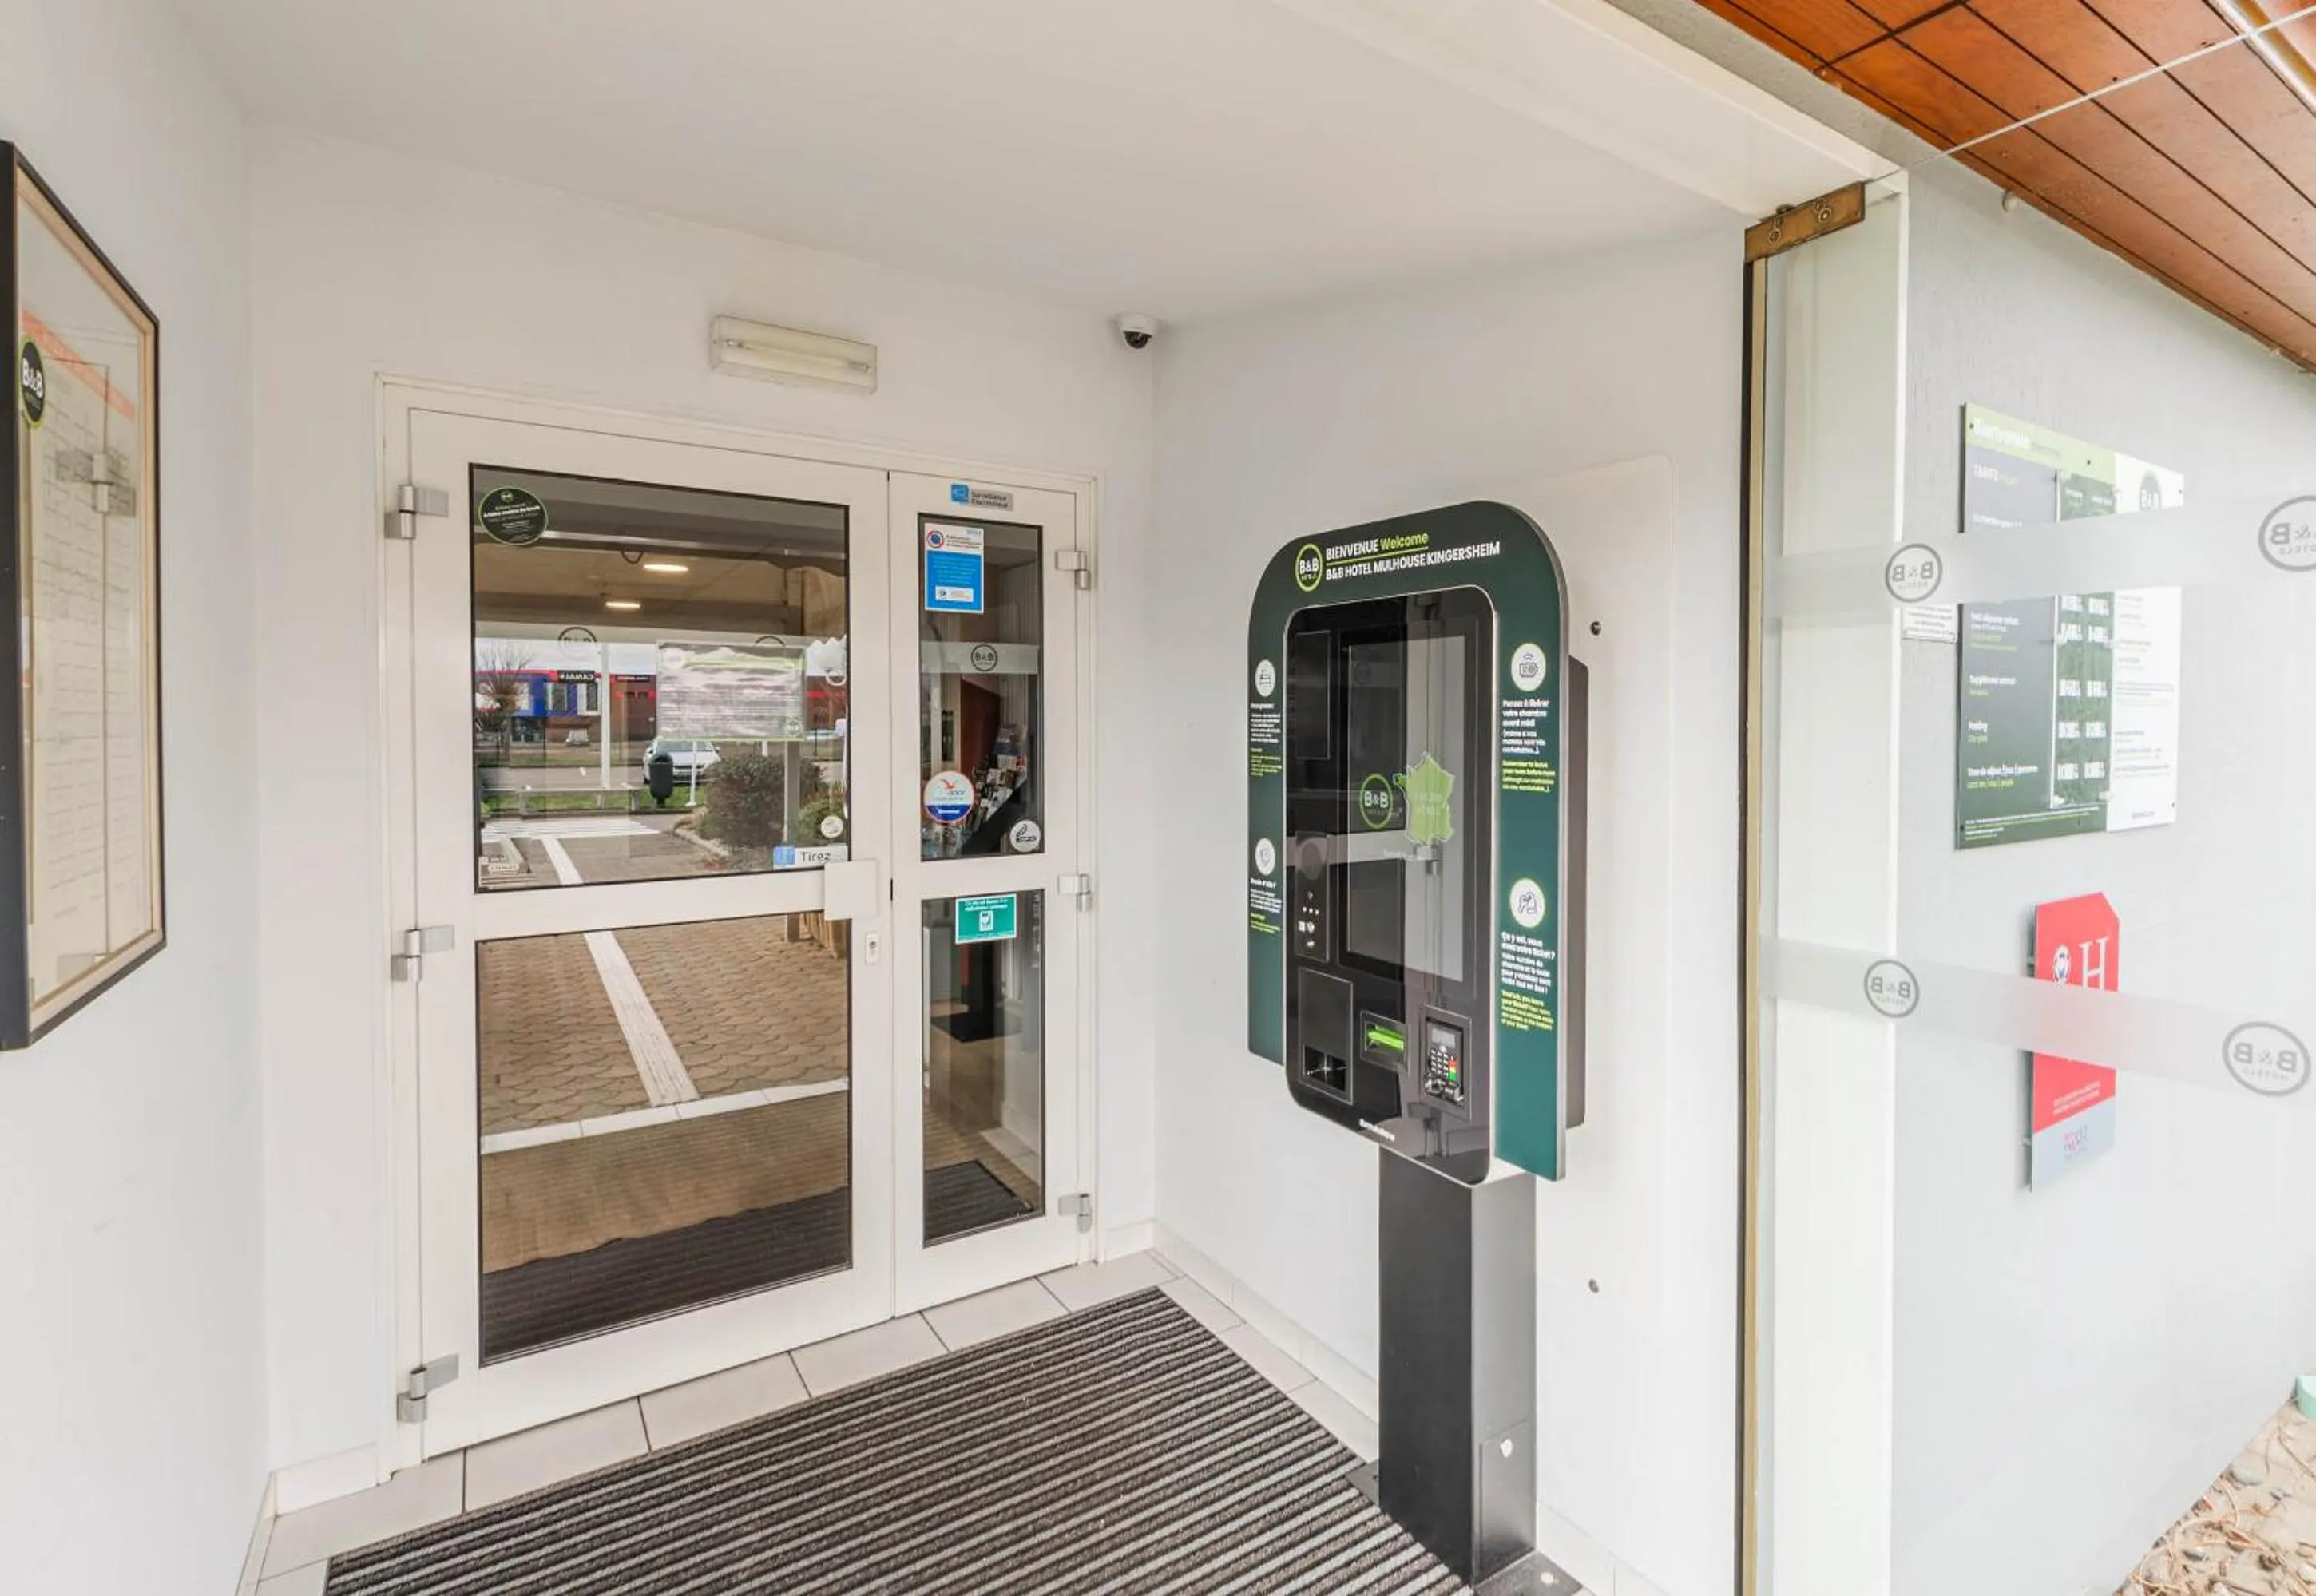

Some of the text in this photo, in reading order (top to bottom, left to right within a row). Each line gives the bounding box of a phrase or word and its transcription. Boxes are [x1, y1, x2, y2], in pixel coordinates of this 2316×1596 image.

[22, 358, 43, 398] B&B
[1326, 533, 1430, 560] BIENVENUE Welcome
[1299, 557, 1319, 574] B&B
[1326, 541, 1501, 581] B&B HOTEL MULHOUSE KINGERSHEIM
[1364, 790, 1388, 808] B&B
[800, 852, 831, 863] Tirez
